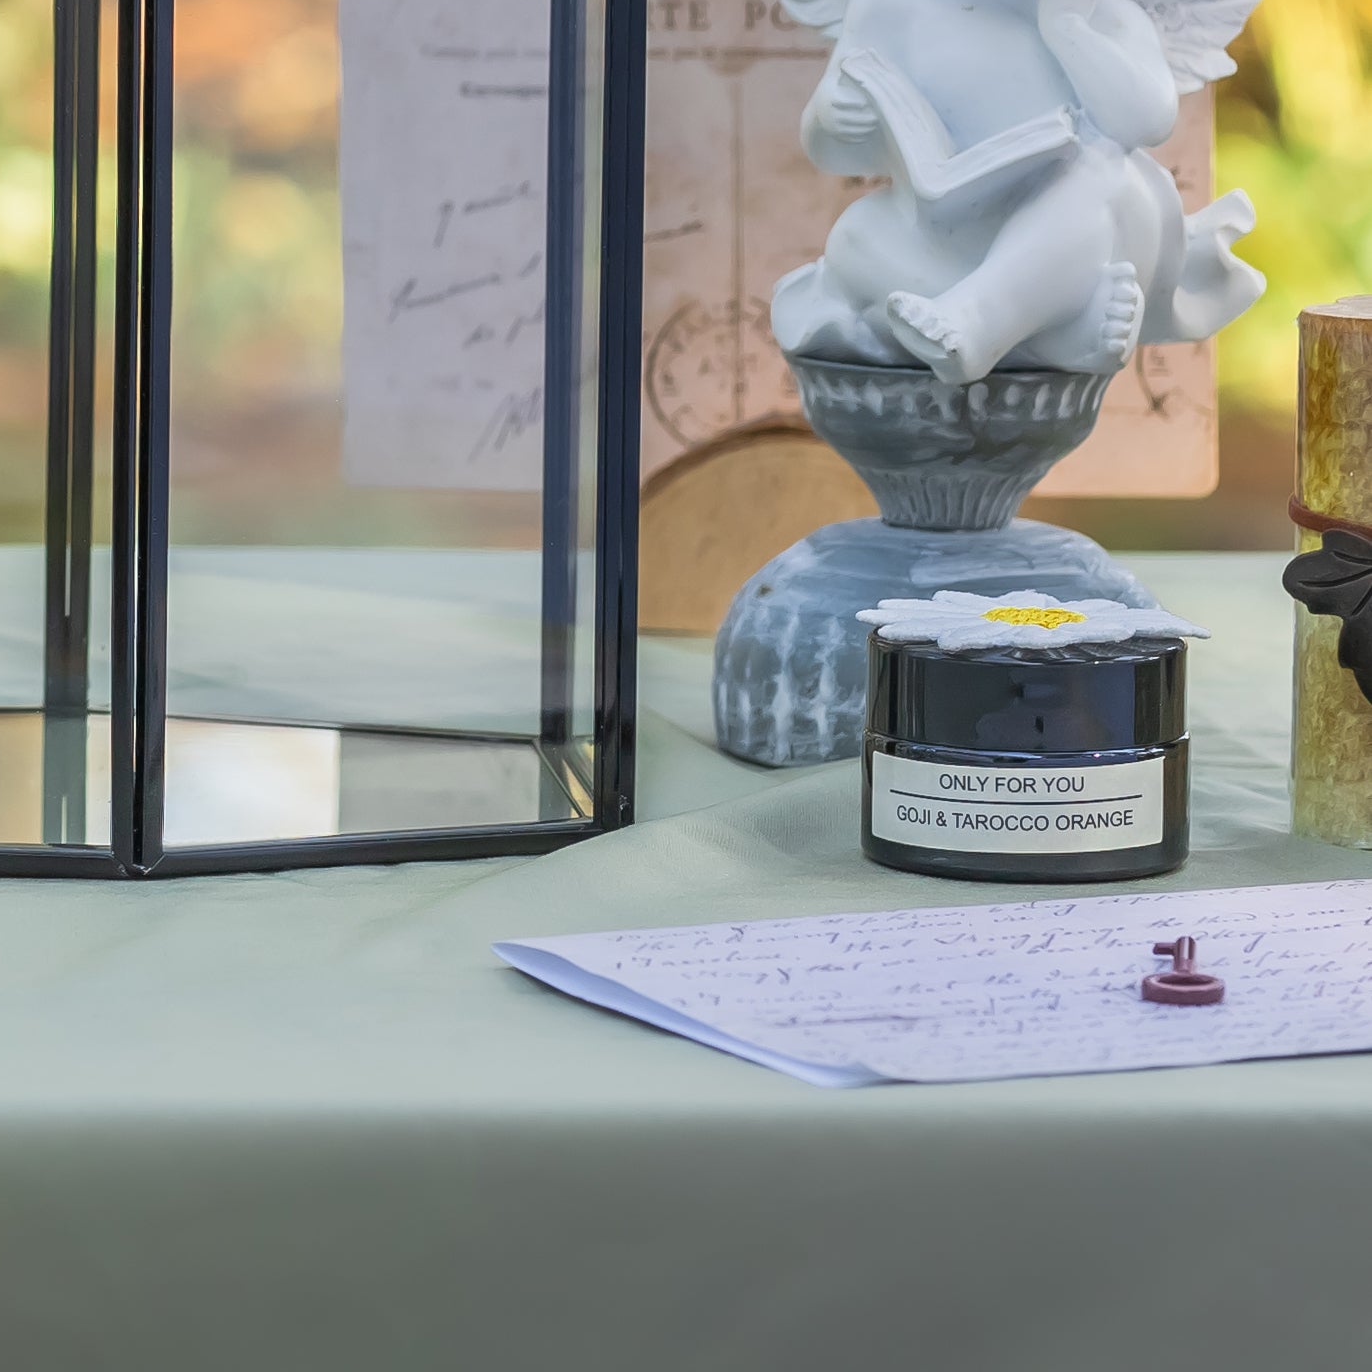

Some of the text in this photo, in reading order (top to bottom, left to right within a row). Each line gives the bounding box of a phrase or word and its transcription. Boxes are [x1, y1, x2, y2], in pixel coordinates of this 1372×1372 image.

[939, 773, 1085, 794] ONLY FOR YOU
[896, 804, 1134, 832] GOJI & TAROCCO ORANGE
